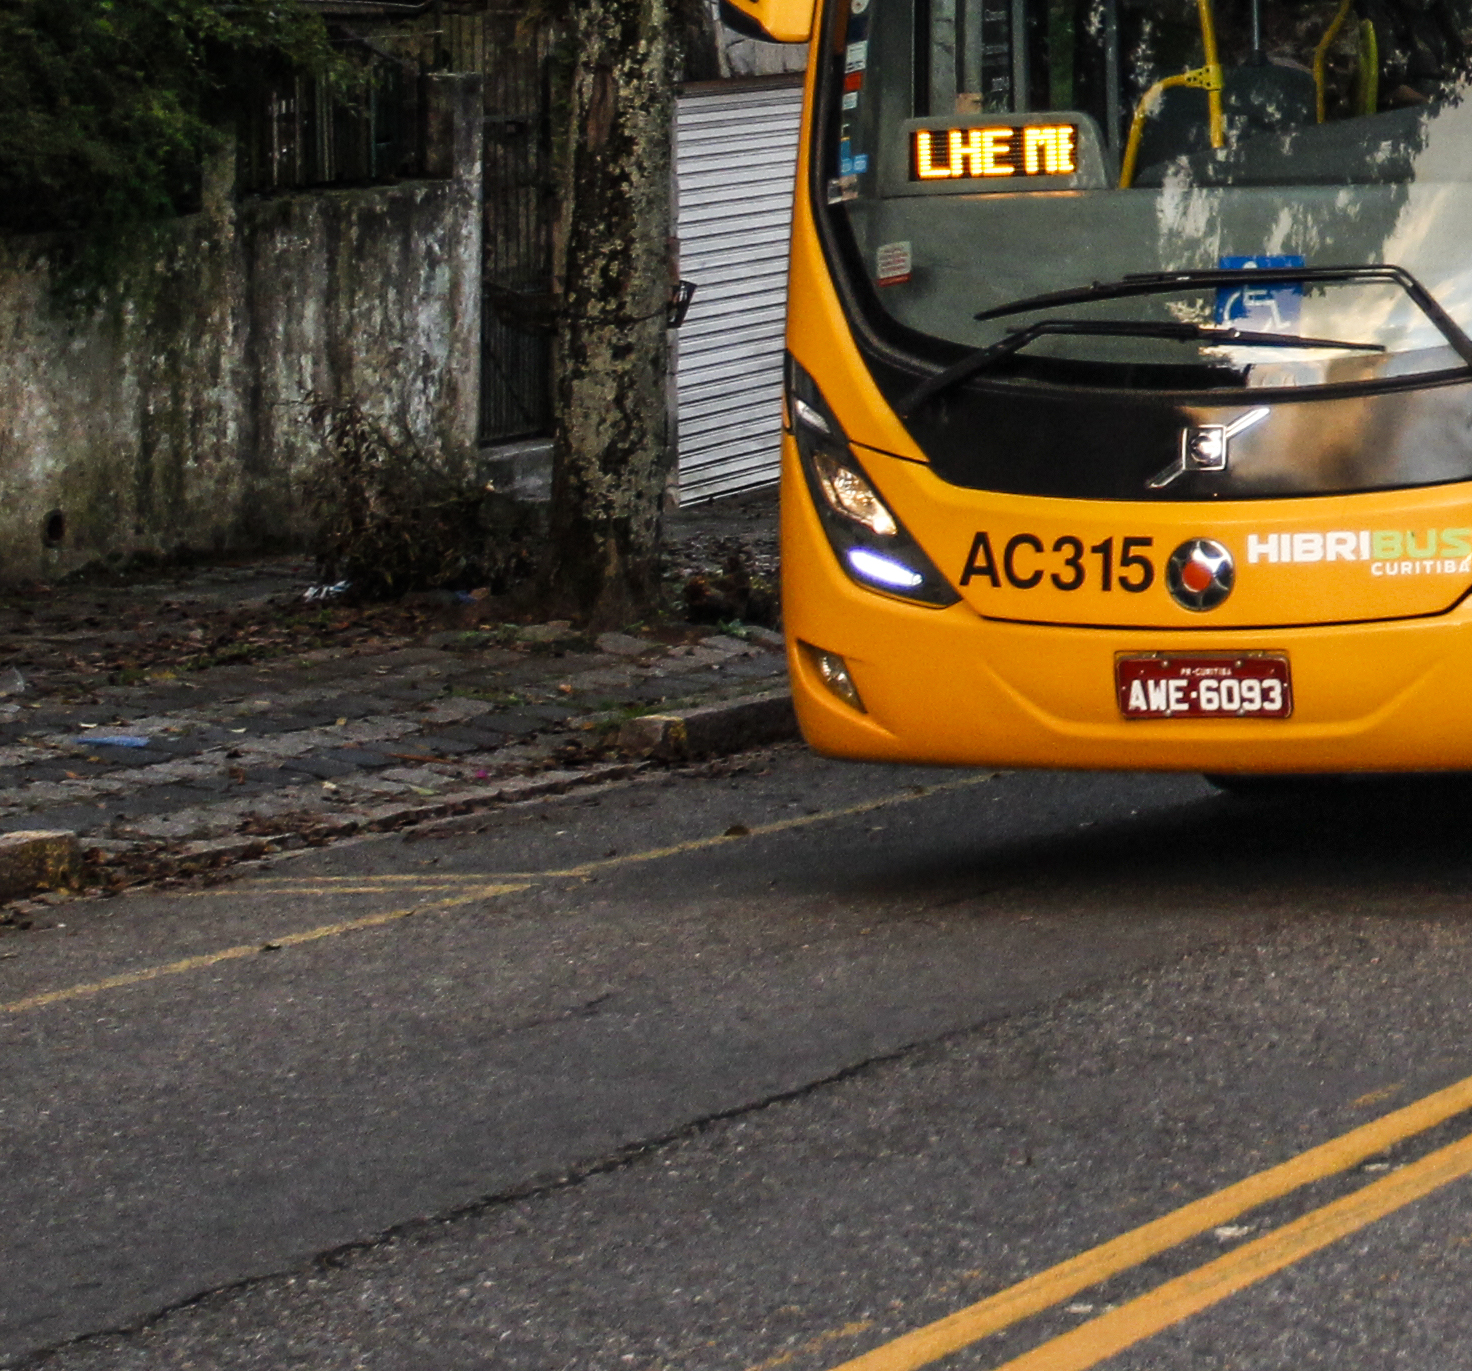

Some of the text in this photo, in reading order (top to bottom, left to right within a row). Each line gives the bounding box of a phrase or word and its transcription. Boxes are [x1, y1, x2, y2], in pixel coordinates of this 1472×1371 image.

[917, 129, 1015, 179] LHE
[959, 531, 1155, 593] AC315
[1370, 559, 1471, 576] CURITIBA
